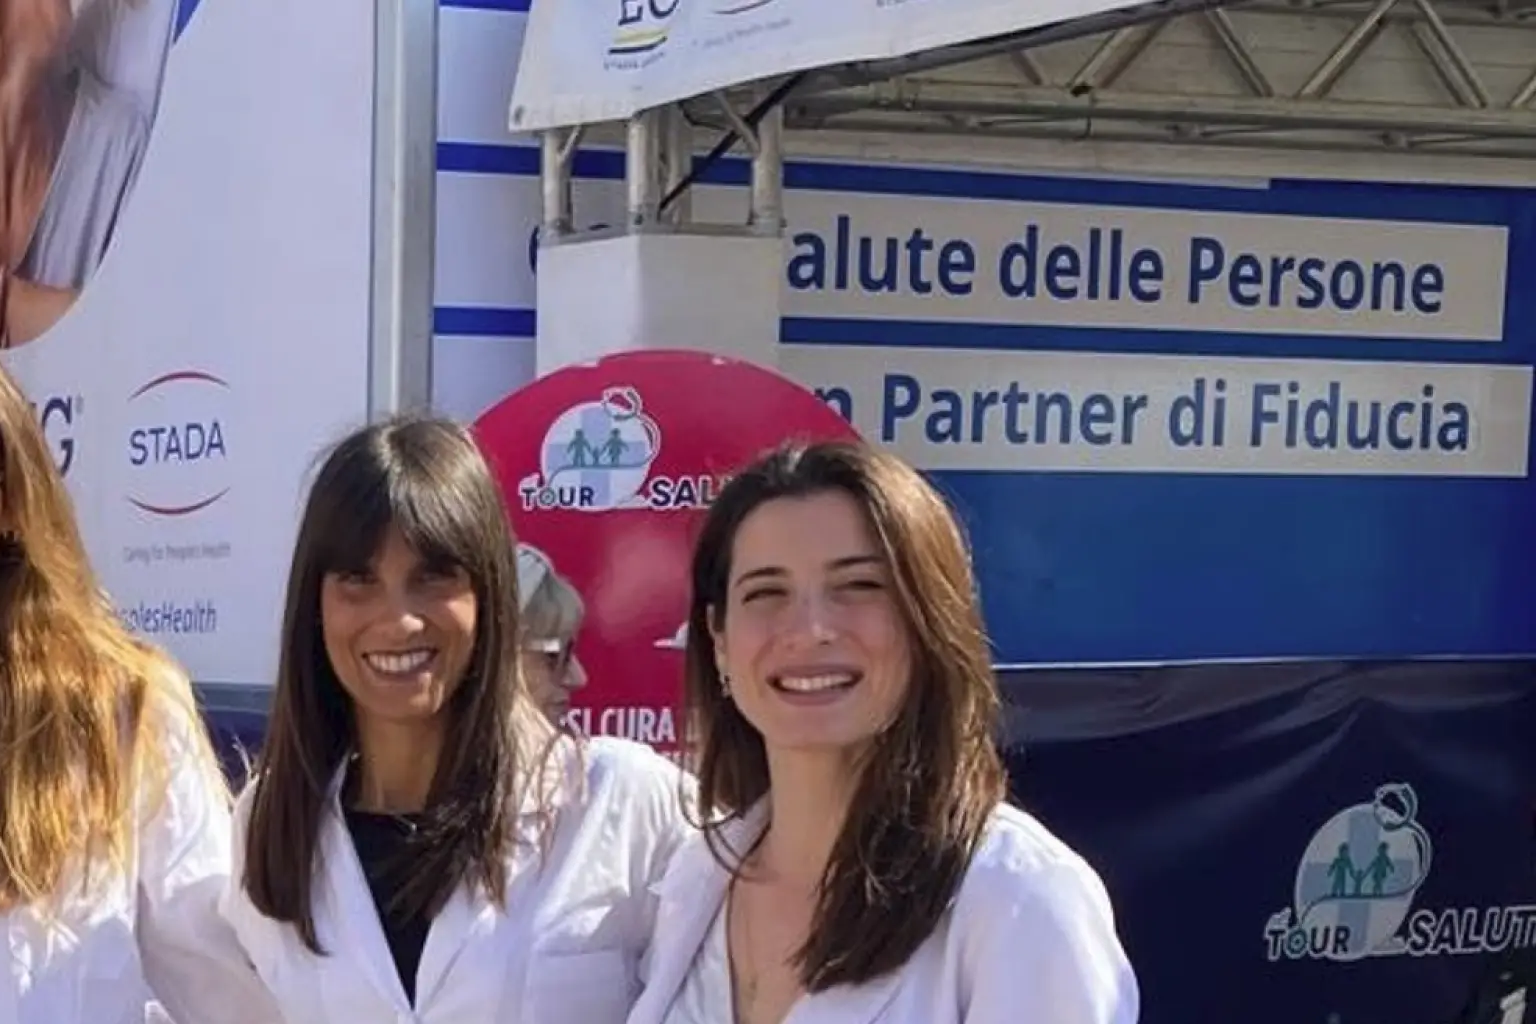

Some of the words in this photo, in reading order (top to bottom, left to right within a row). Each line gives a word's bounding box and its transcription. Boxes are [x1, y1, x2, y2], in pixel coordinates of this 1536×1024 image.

[785, 214, 976, 296] alute
[998, 224, 1165, 303] delle
[1187, 236, 1446, 314] Persone
[880, 373, 1149, 445] Partner
[1168, 377, 1227, 448] di
[1249, 379, 1471, 453] Fiducia
[129, 421, 227, 467] STADA
[520, 485, 596, 508] TOUR
[649, 476, 718, 508] SAL
[600, 706, 677, 743] CURA
[1267, 926, 1352, 960] TOUR
[1405, 907, 1536, 955] SALUT
